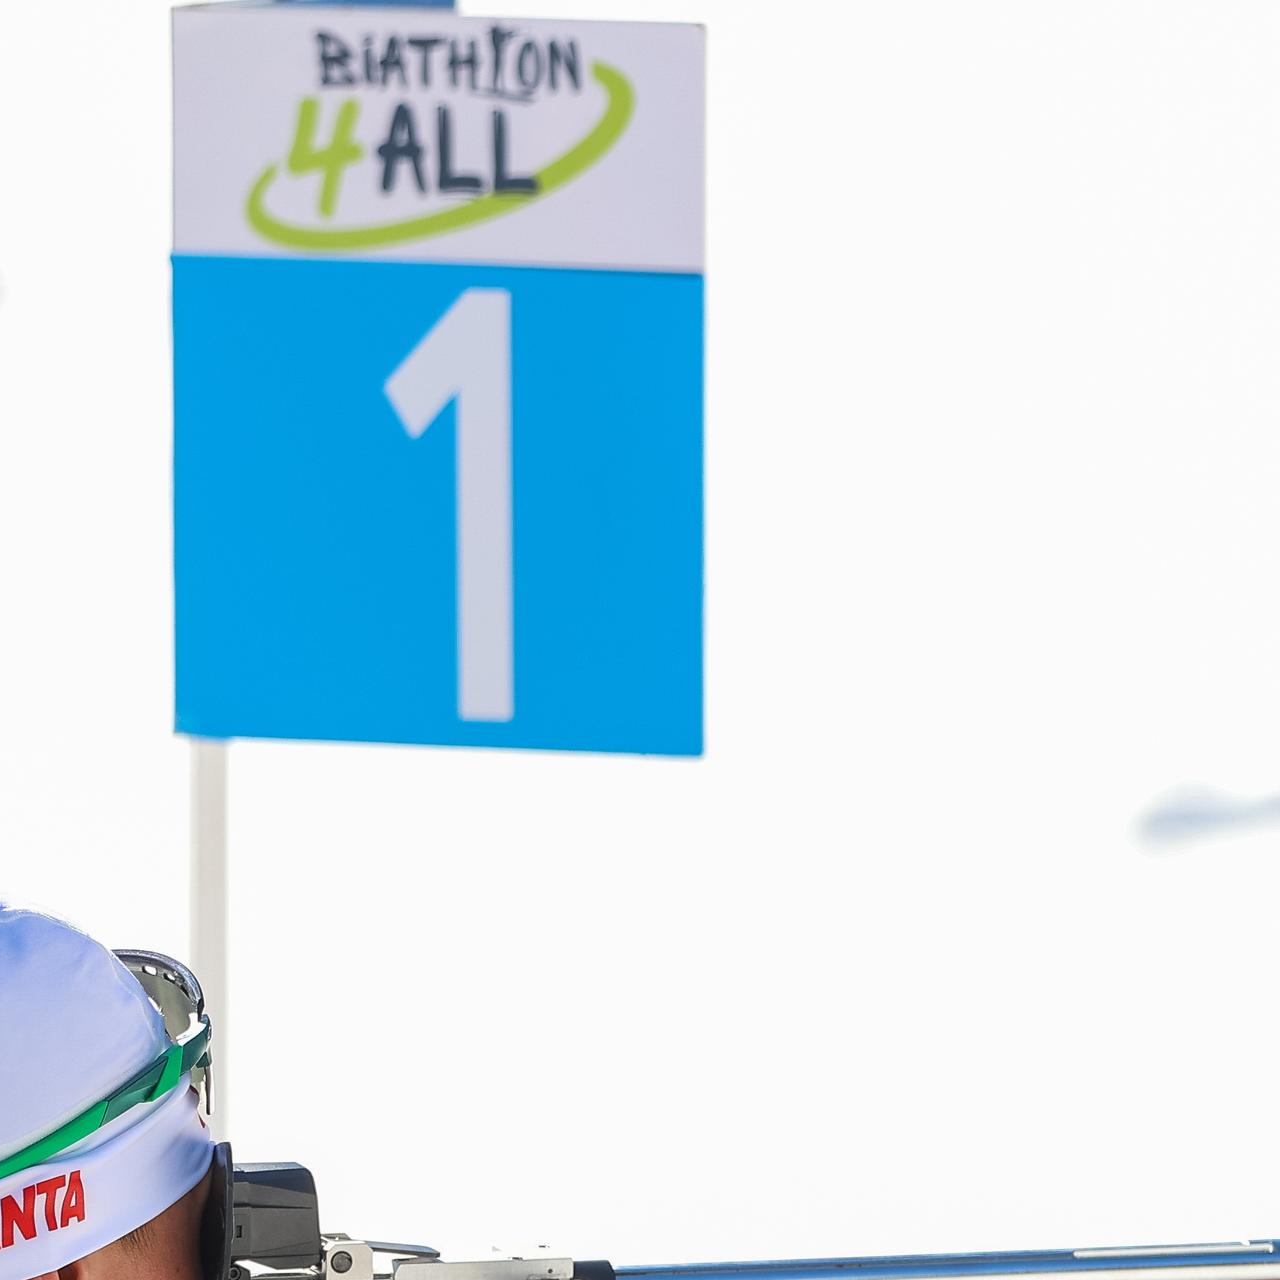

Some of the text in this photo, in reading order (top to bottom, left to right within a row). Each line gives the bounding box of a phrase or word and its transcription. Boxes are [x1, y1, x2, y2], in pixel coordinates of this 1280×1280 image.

[286, 98, 542, 220] 4 ALL
[382, 286, 514, 724] 1
